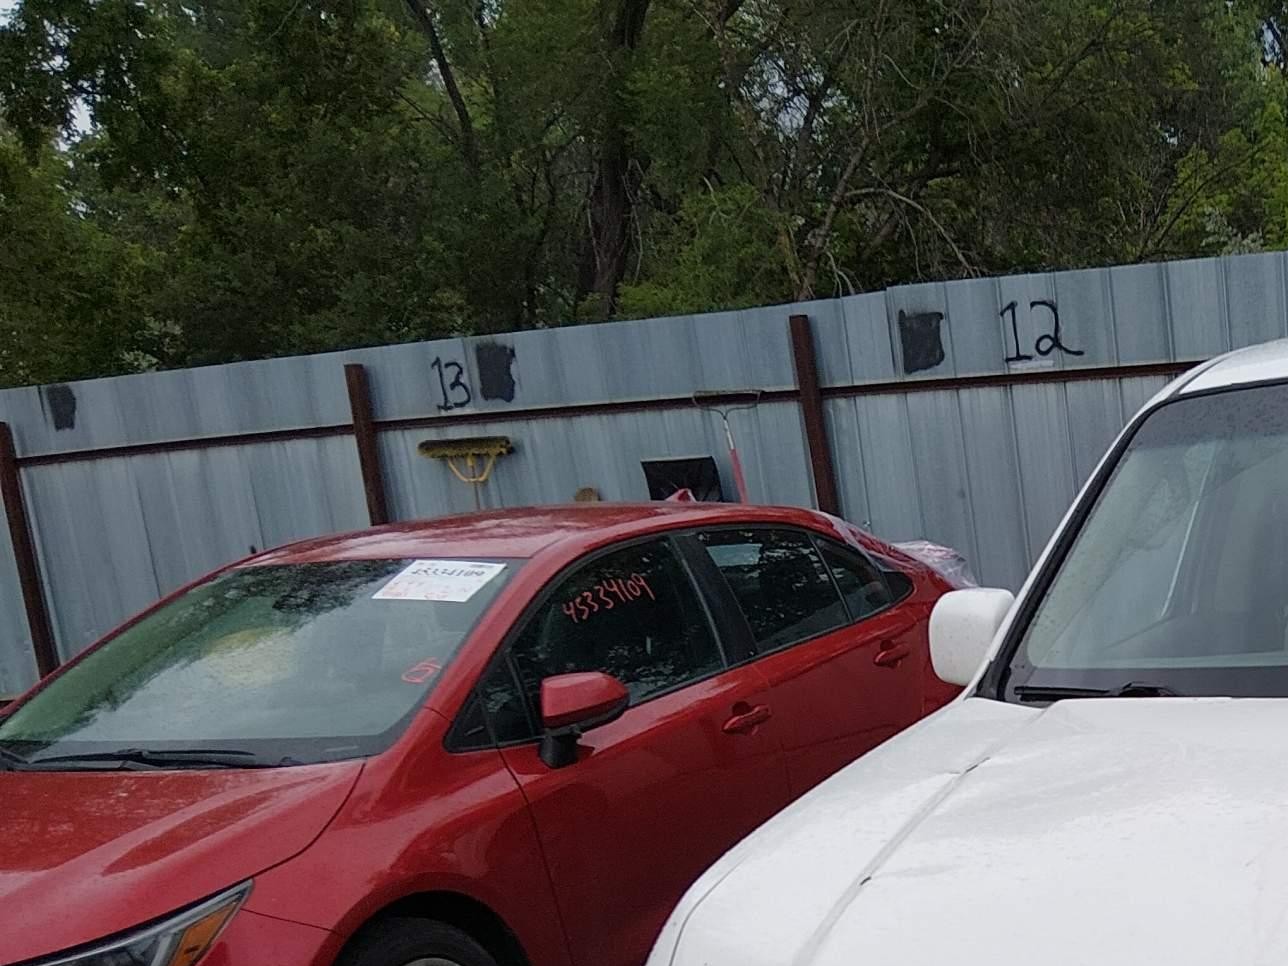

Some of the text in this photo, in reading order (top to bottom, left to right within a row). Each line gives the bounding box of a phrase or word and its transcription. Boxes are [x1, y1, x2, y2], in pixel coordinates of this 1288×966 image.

[1000, 300, 1085, 363] 12
[431, 356, 471, 411] 13
[562, 573, 656, 624] 45334109
